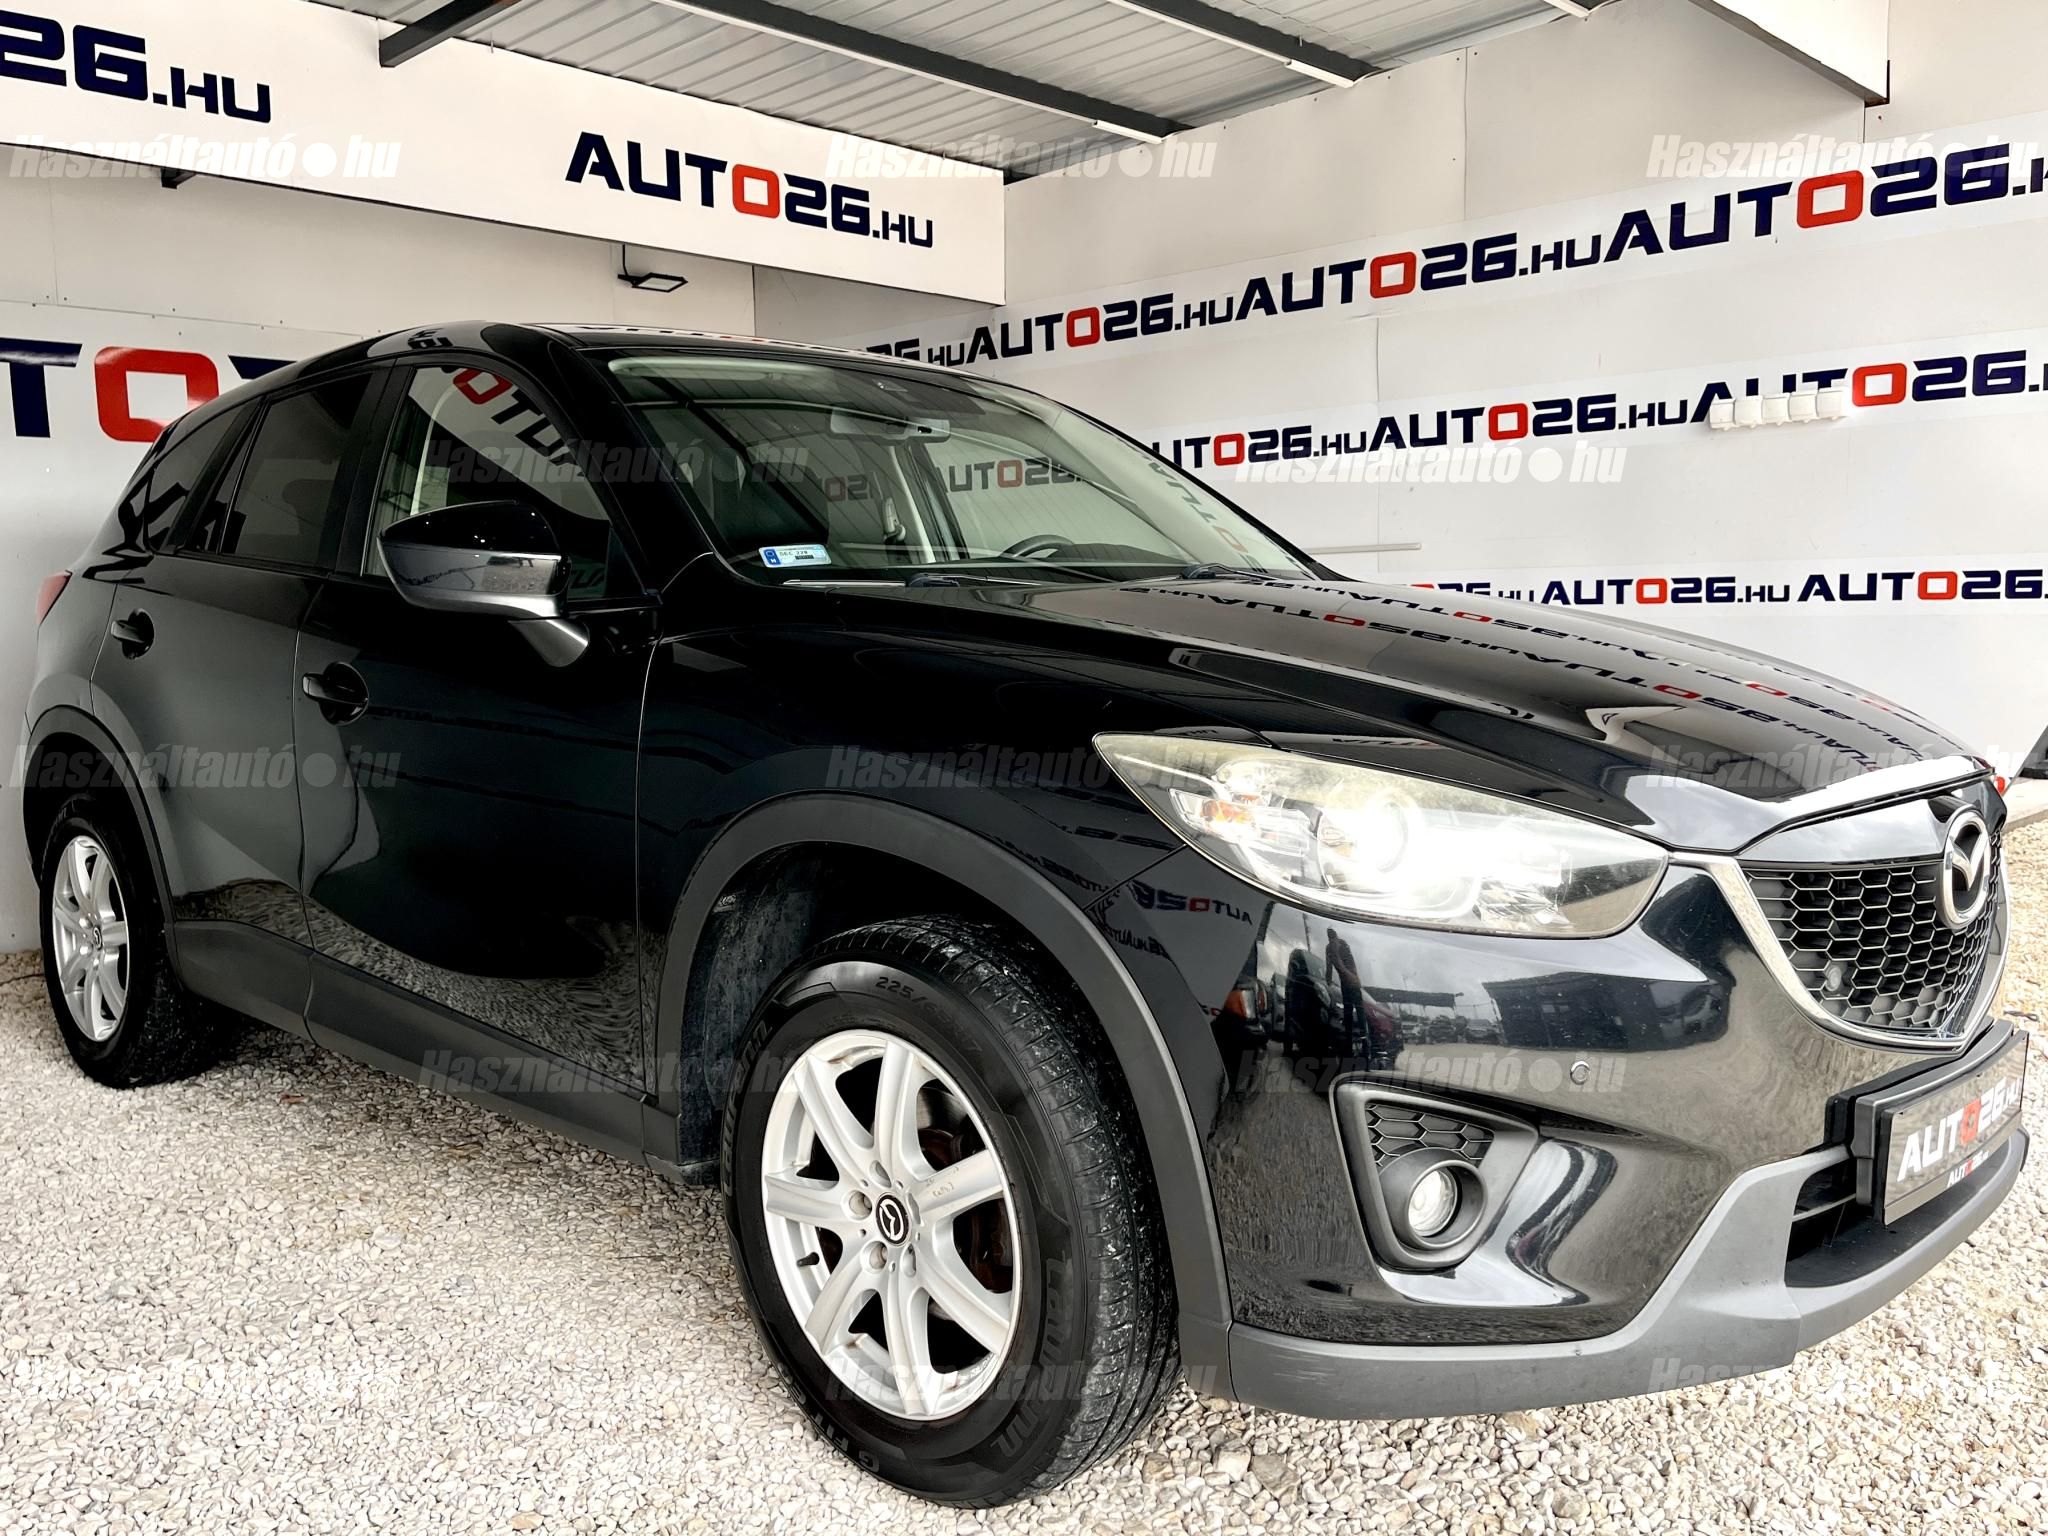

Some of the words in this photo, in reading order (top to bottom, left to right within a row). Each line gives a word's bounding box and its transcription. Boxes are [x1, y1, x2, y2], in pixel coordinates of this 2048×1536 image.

[565, 130, 933, 248] AUTO26.HU
[967, 293, 1234, 364] AUTO26.HU
[1235, 232, 1602, 321] AUTO26.HU
[1368, 393, 1688, 453] AUTO26.HU
[1541, 575, 1790, 605] AUTO26.HU
